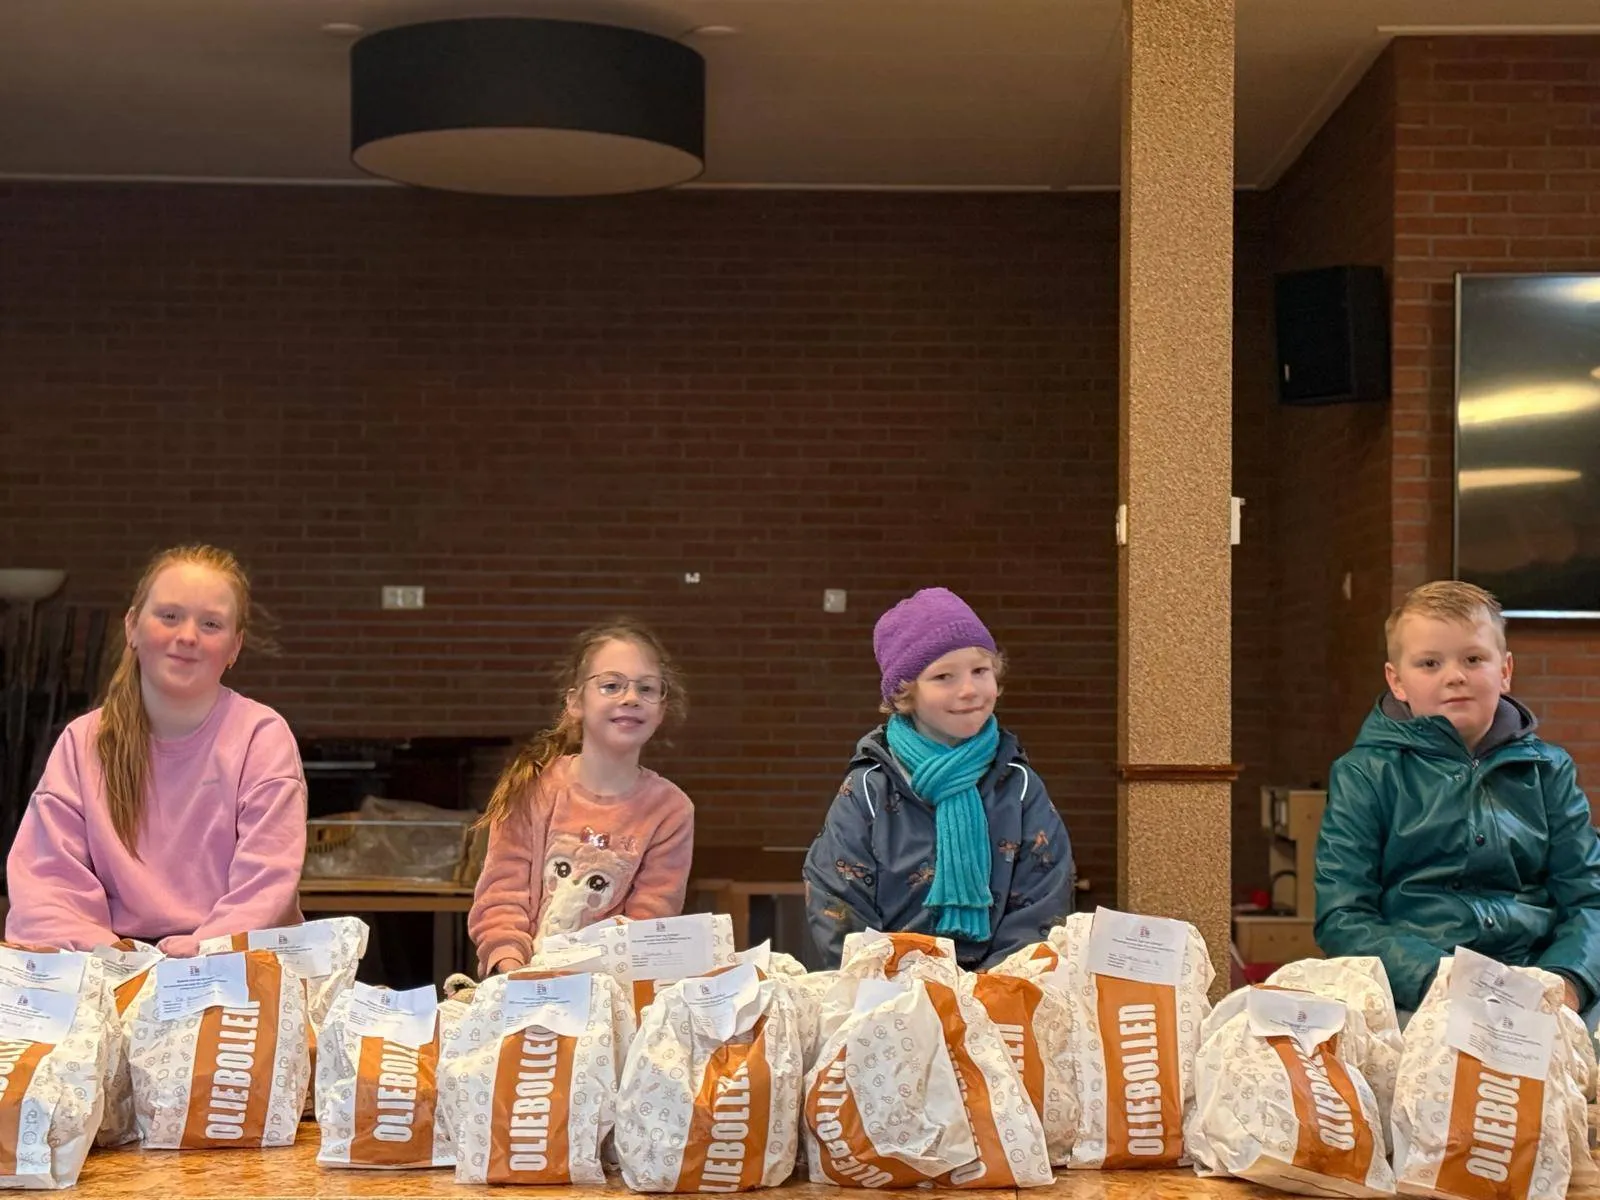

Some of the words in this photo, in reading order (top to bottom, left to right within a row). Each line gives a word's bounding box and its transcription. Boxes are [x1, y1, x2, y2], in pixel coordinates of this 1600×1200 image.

[373, 1044, 420, 1142] OLIEBOLL
[1118, 1003, 1165, 1156] OLIEBOLLEN
[1465, 1071, 1521, 1183] OLIEBOL
